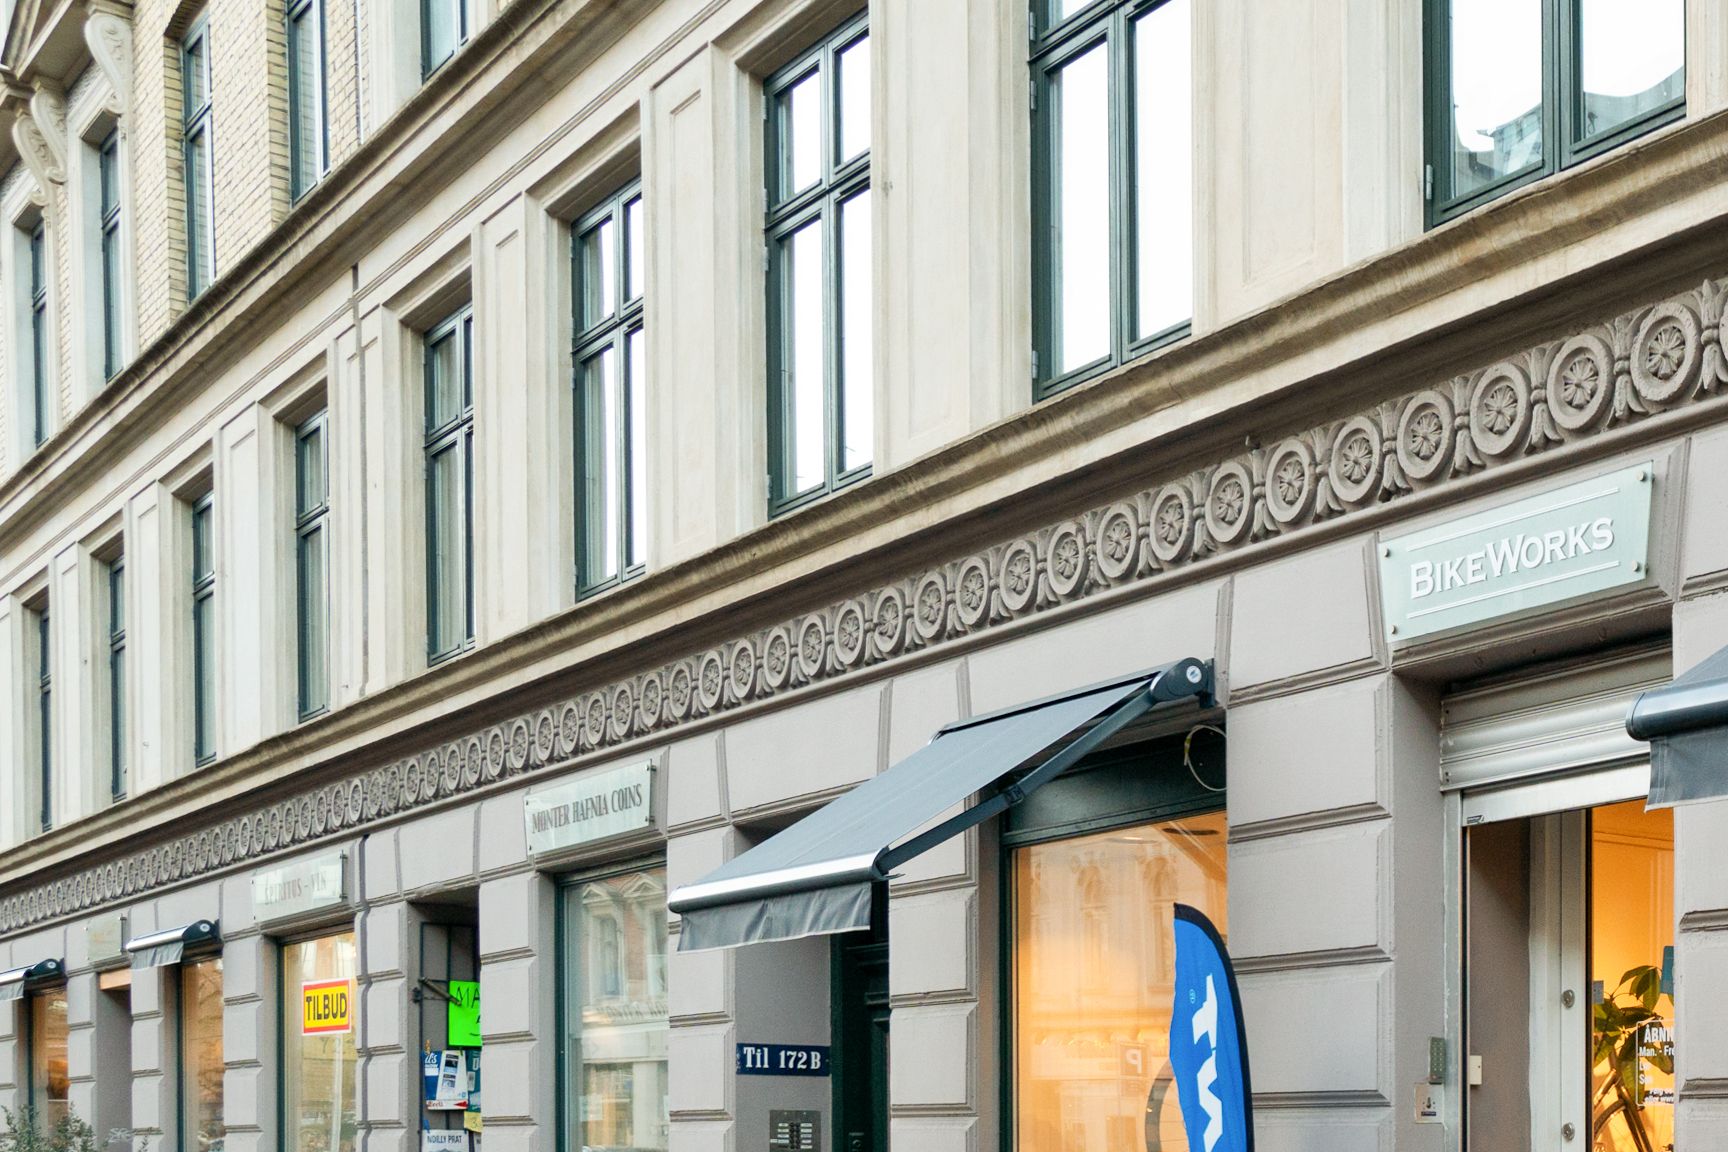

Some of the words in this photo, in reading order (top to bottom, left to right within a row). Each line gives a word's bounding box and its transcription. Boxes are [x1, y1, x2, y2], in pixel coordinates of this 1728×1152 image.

[611, 783, 642, 813] COINS
[305, 993, 348, 1023] TILBUD
[744, 1046, 769, 1068] Til
[448, 1134, 462, 1144] PRAT
